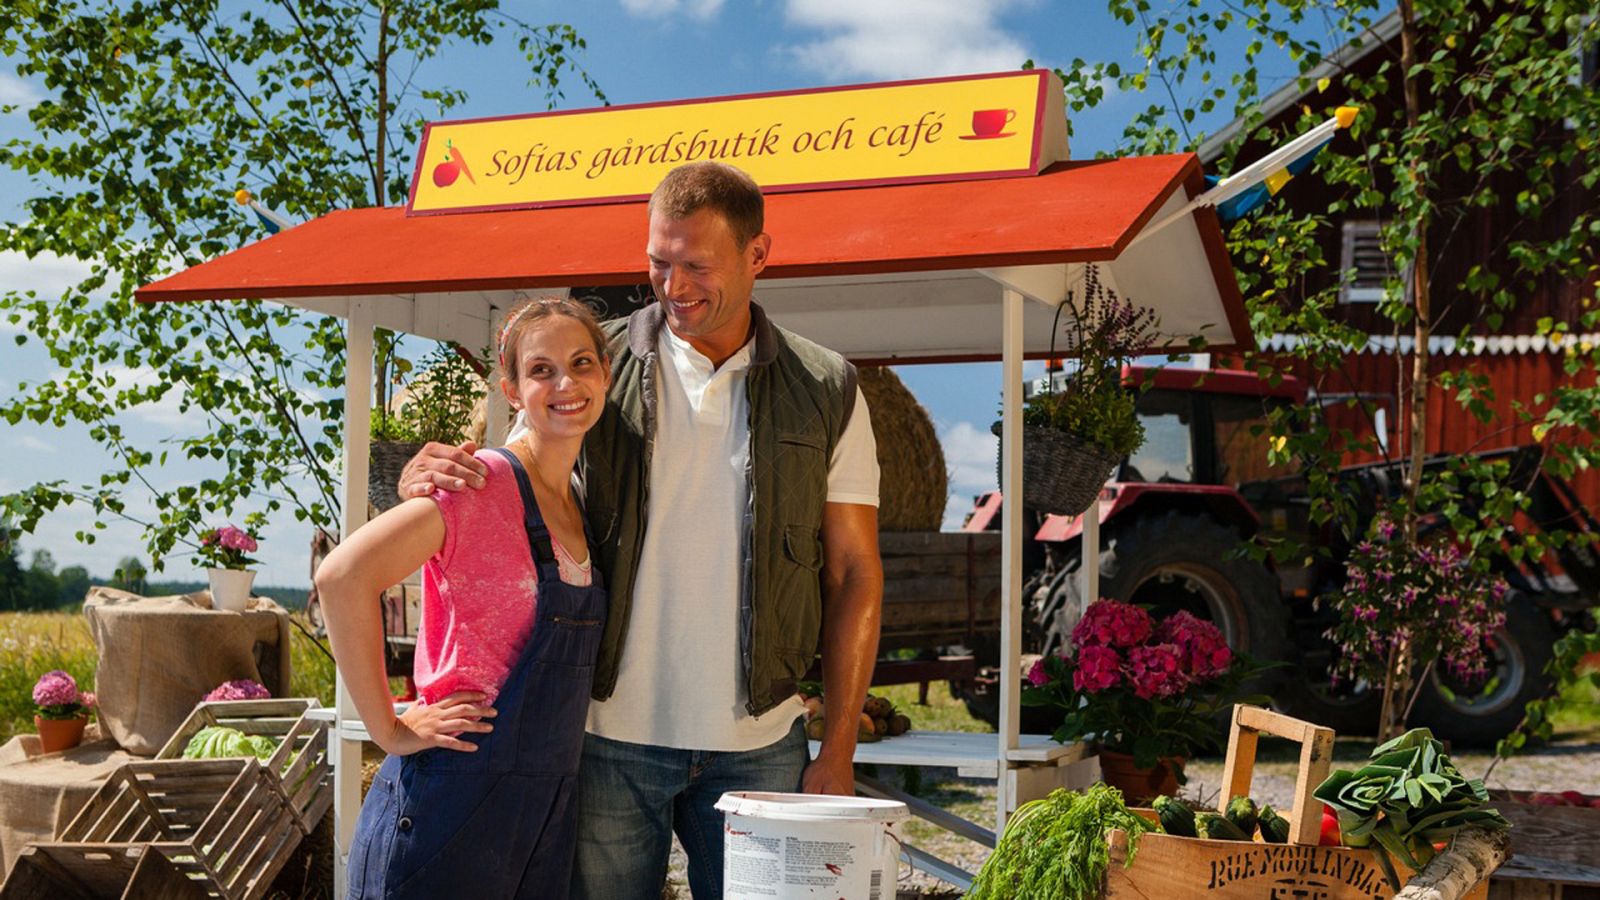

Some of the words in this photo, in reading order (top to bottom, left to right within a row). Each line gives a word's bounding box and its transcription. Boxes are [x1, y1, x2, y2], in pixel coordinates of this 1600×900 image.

[485, 142, 582, 185] Sofias
[585, 122, 782, 180] gårdsbutik
[792, 117, 856, 154] och
[868, 111, 946, 157] café
[1208, 850, 1258, 890] RUE
[1260, 847, 1350, 880] MOULIN
